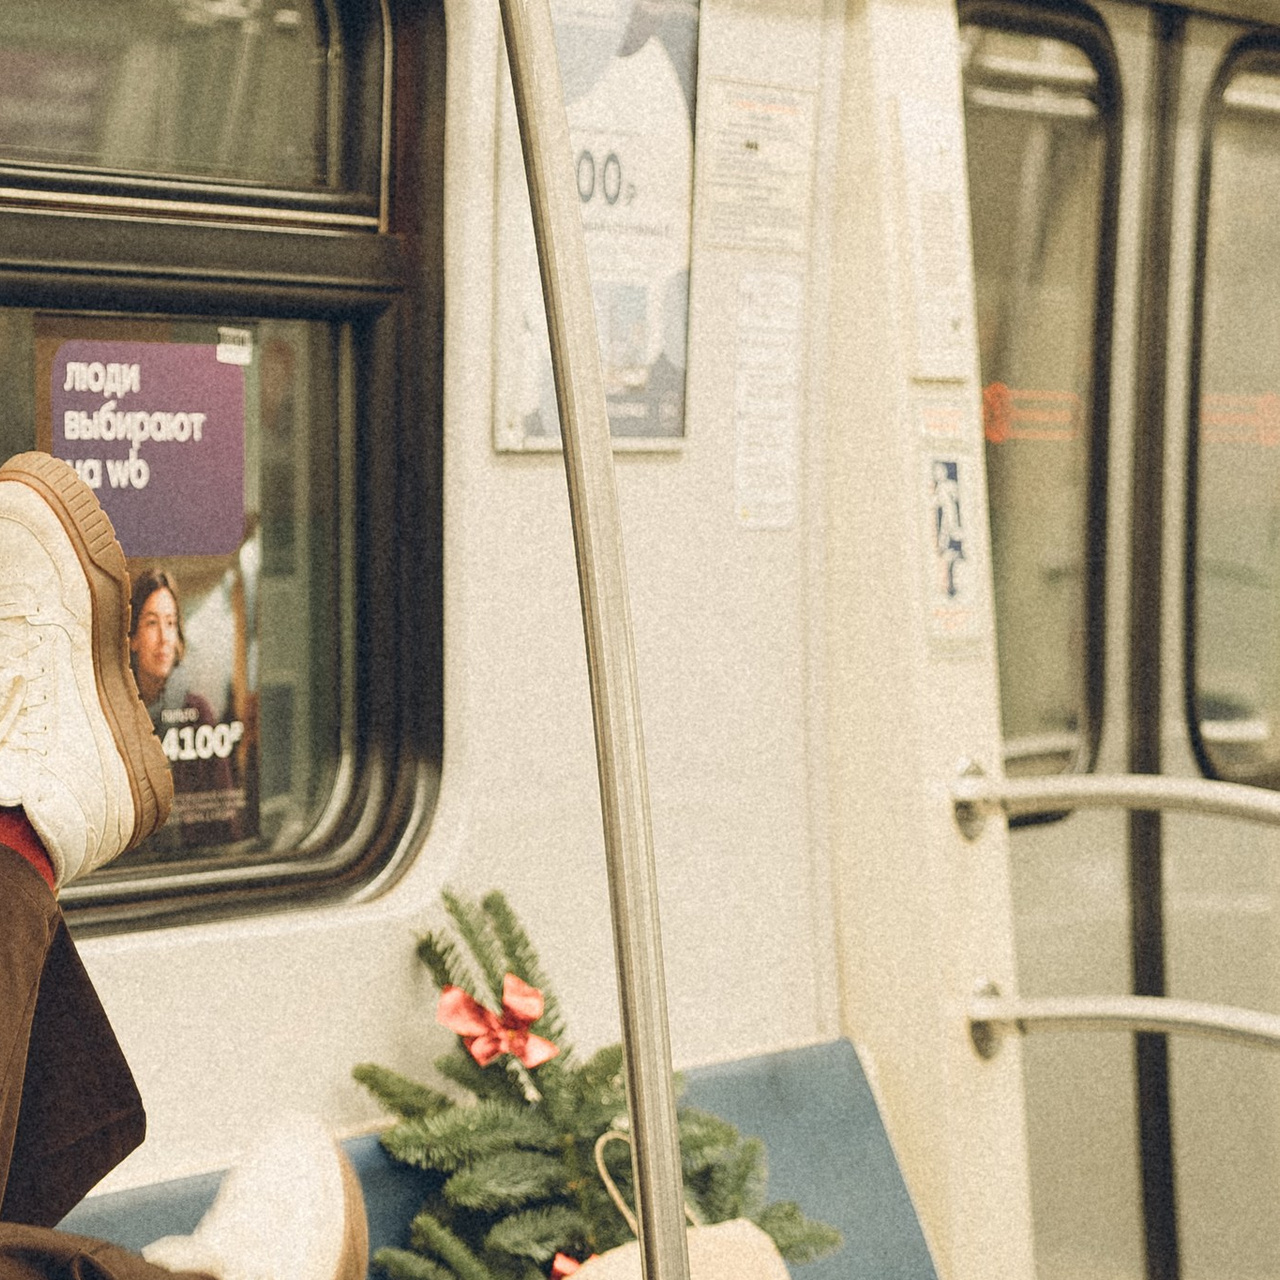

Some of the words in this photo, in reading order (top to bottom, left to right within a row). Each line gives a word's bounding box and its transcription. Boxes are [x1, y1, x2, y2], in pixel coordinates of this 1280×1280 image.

[63, 361, 141, 398] люди
[64, 400, 207, 450] выбирают
[106, 448, 151, 489] wb
